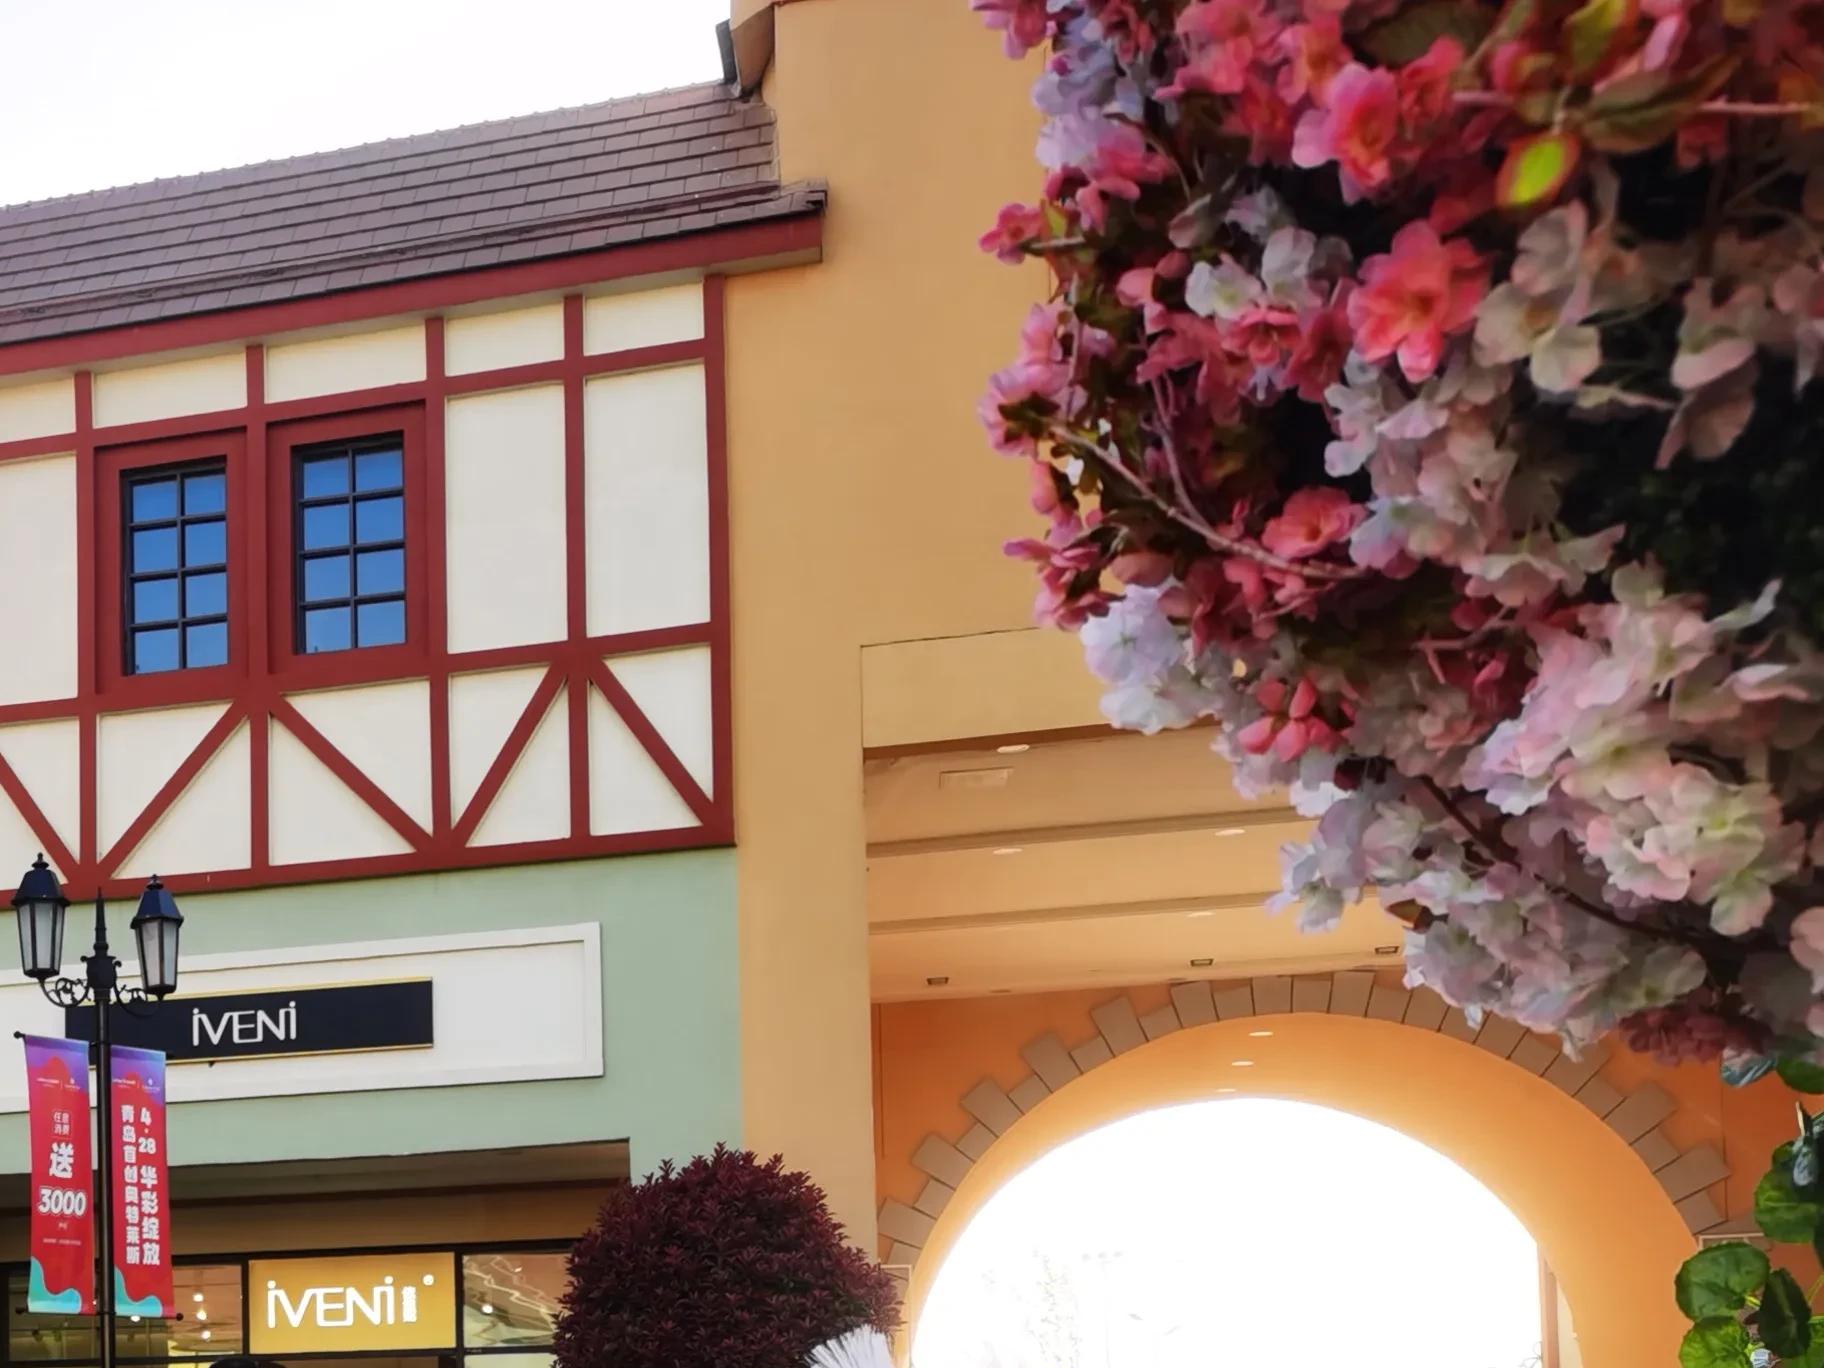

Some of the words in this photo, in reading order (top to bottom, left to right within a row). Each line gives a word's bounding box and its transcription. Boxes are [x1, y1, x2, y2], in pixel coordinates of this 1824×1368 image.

[49, 1142, 74, 1179] 送
[38, 1187, 87, 1217] 3000
[140, 1165, 161, 1266] 华彩绽放
